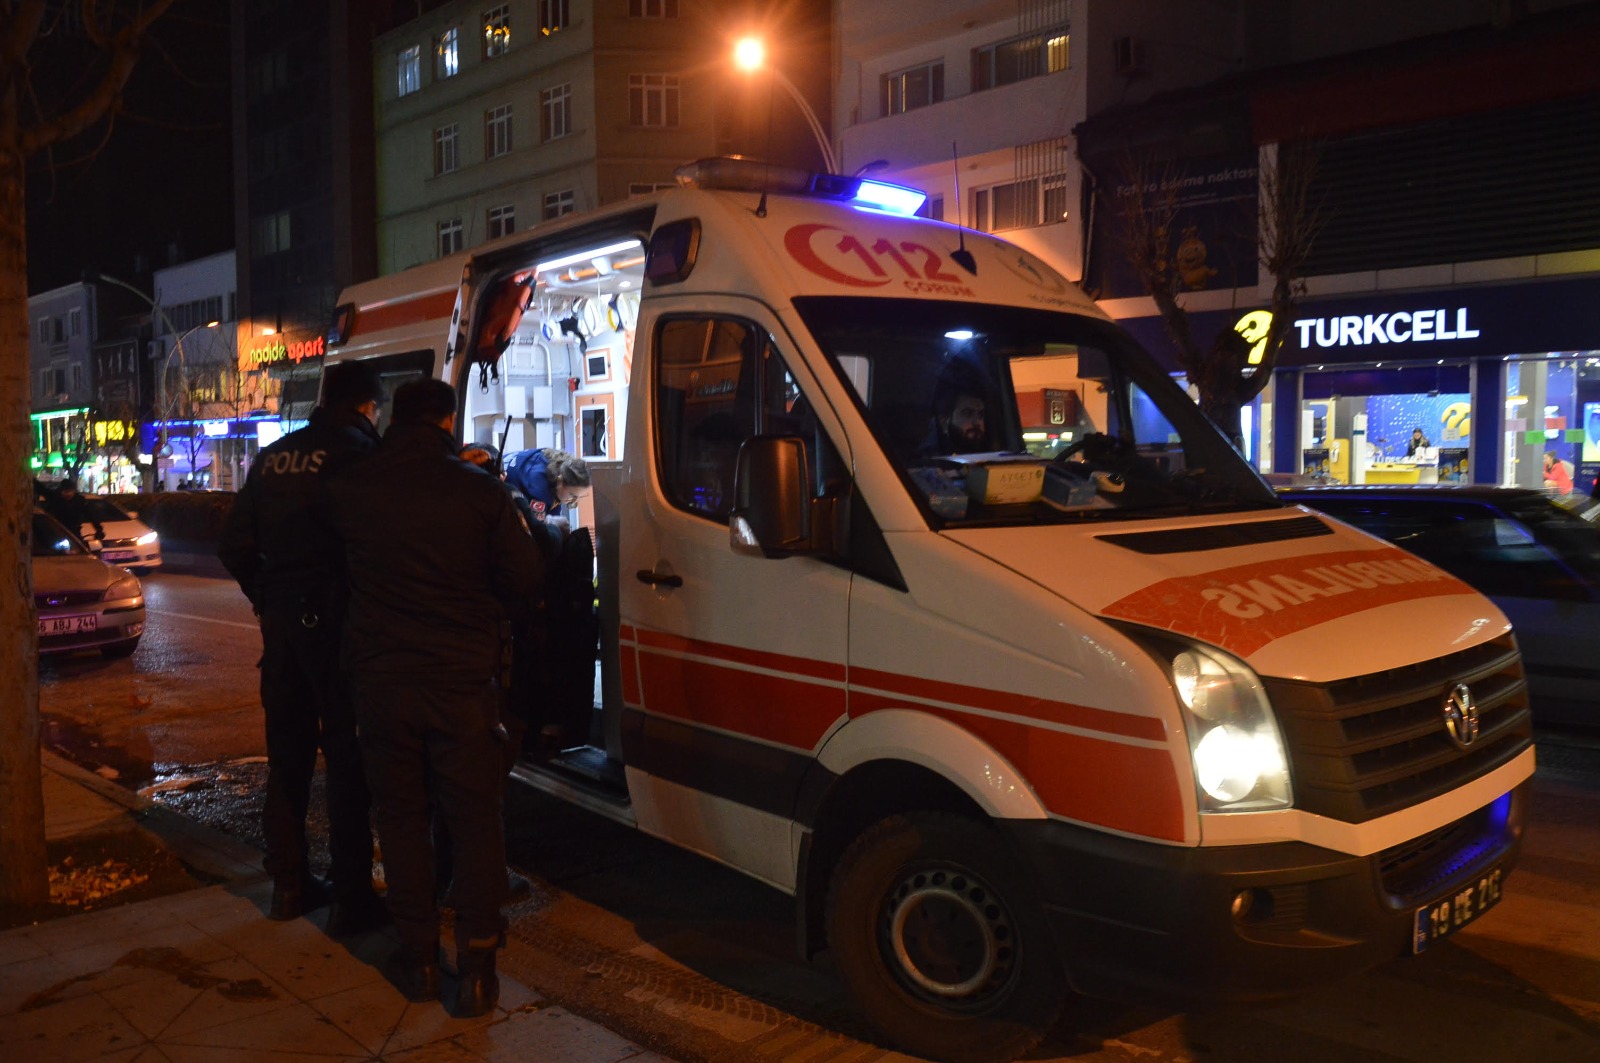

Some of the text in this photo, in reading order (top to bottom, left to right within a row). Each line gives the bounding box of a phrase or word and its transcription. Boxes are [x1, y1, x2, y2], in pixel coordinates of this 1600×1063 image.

[836, 234, 963, 284] 112
[1294, 307, 1480, 349] TURKCELL
[287, 335, 325, 365] apart
